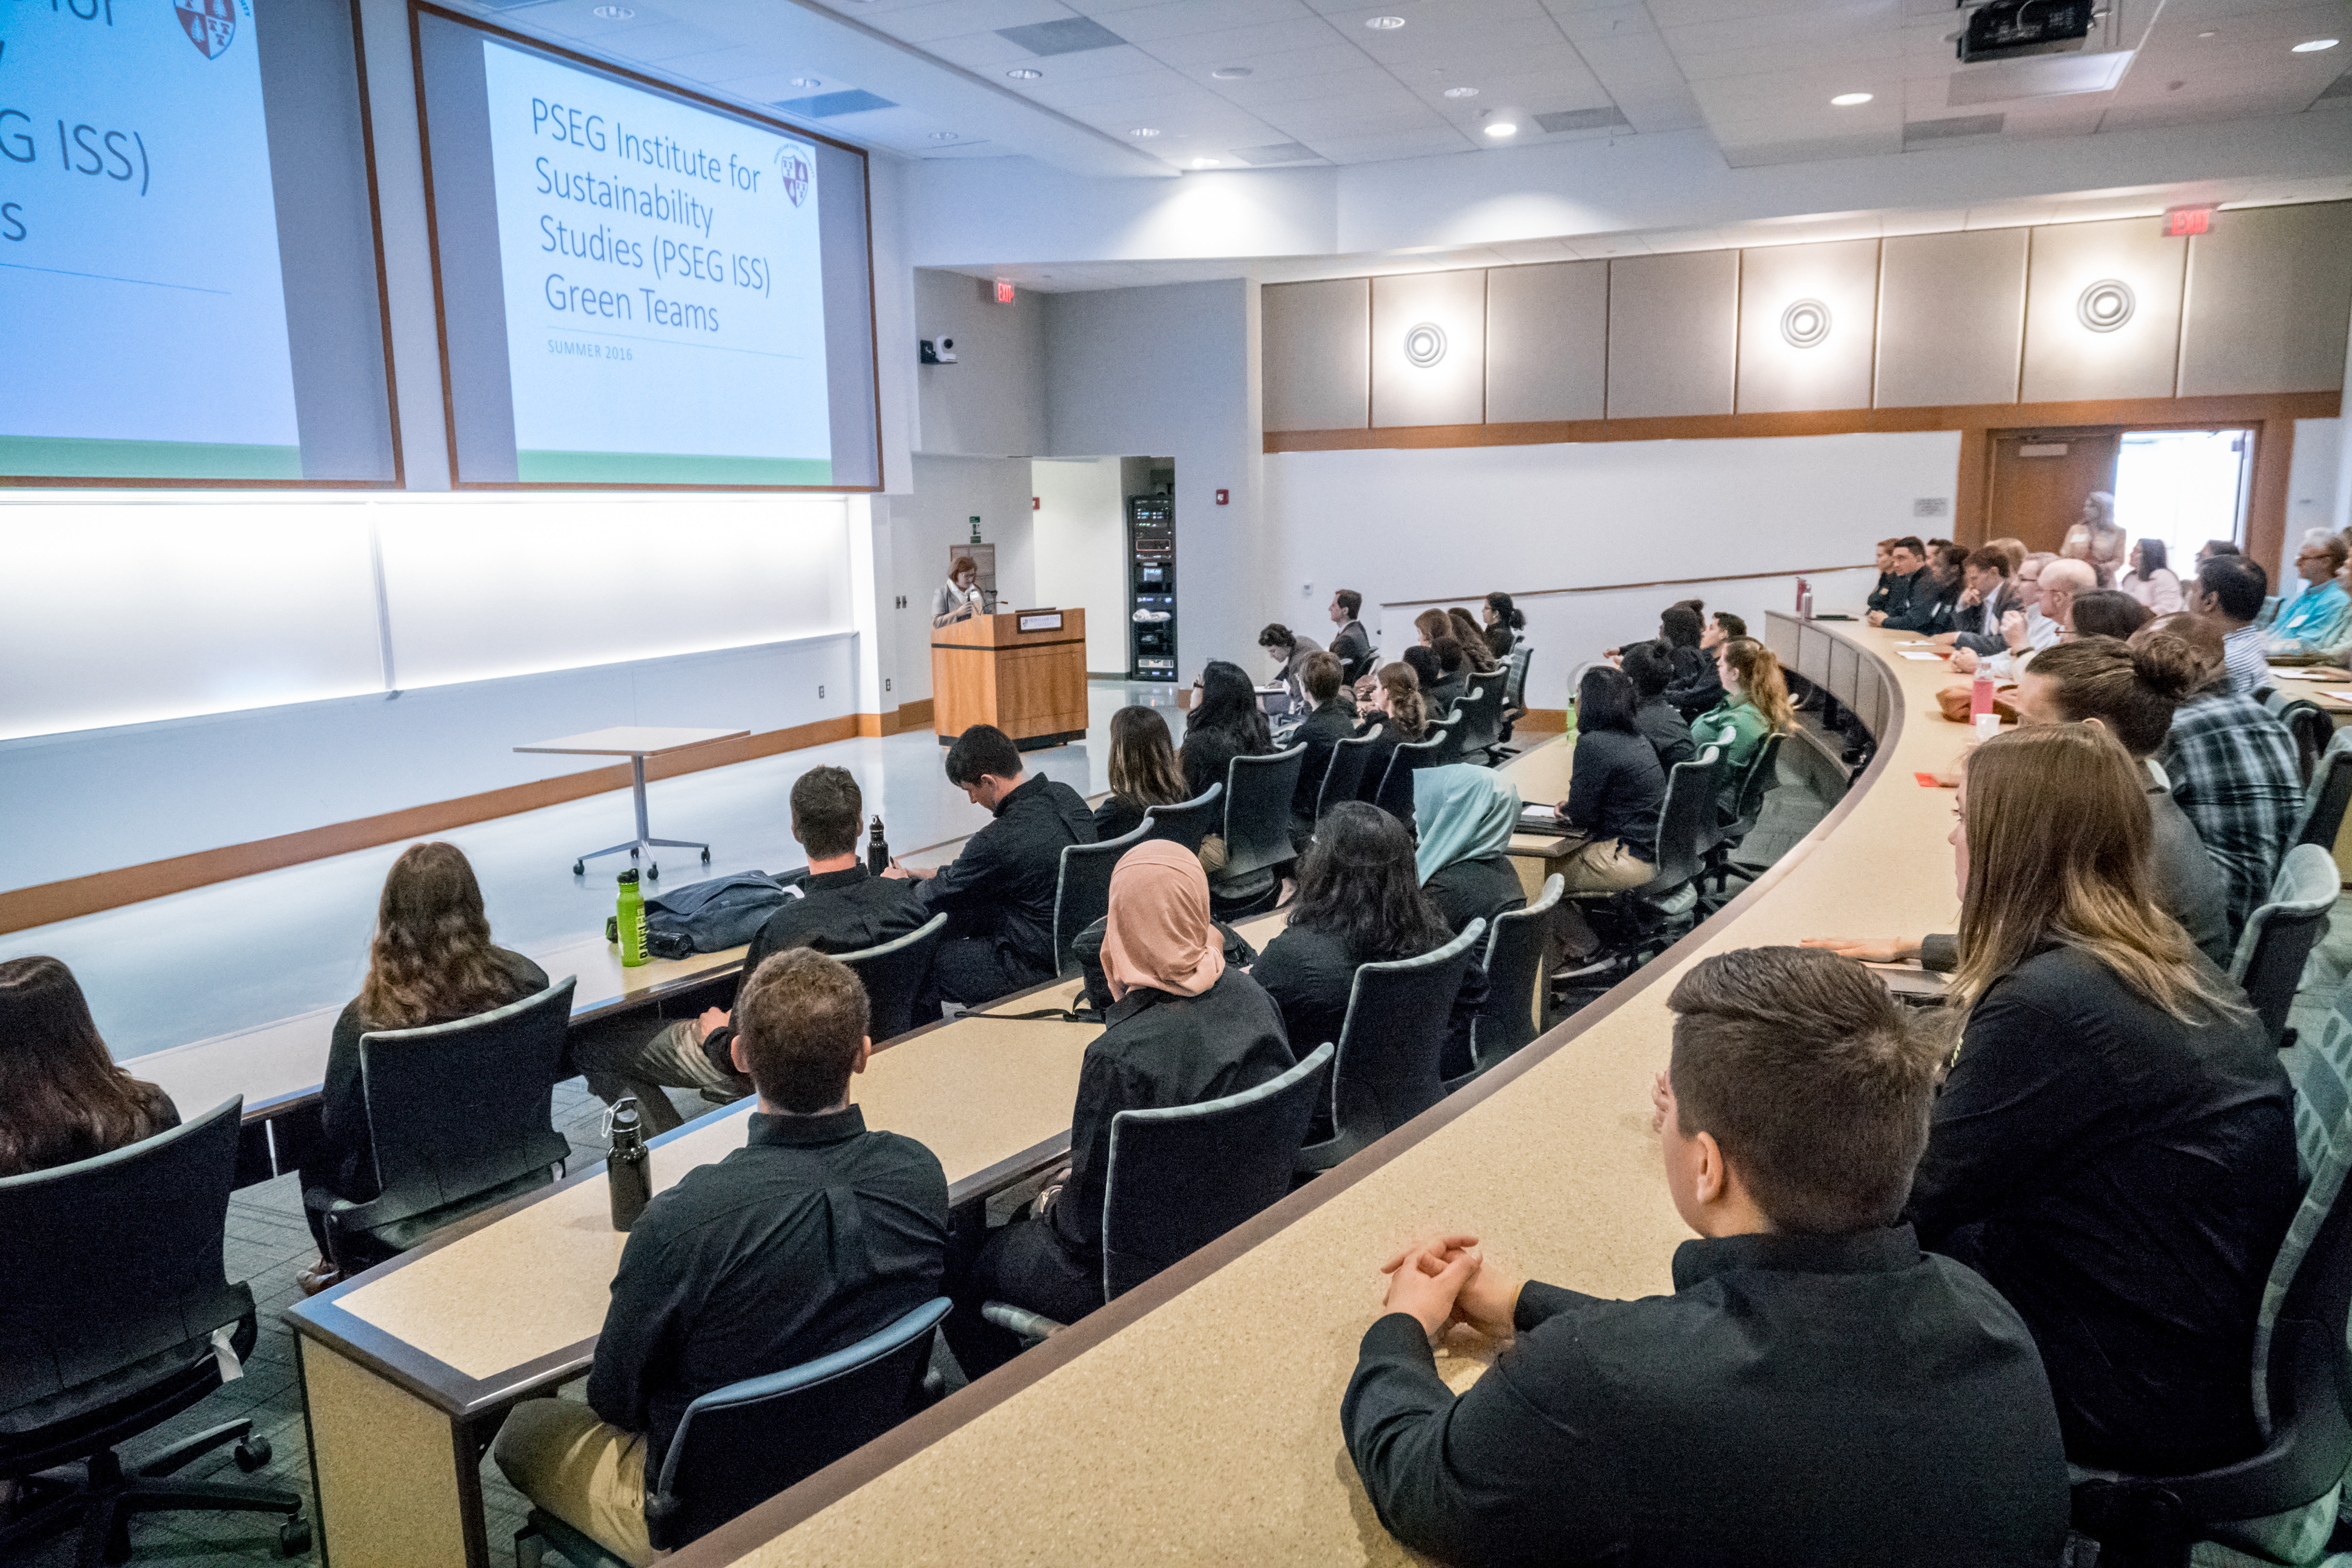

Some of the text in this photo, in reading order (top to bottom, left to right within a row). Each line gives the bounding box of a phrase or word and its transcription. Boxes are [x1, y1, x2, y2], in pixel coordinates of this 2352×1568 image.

[58, 119, 149, 197] ISS)
[532, 98, 606, 152] PSEG
[617, 122, 722, 183] Institute
[728, 154, 761, 193] for
[535, 156, 713, 238] Sustainability
[2171, 209, 2212, 235] EXIT
[540, 214, 770, 299] Studies (PSEG ISS)
[545, 274, 720, 332] Green Teams
[998, 282, 1012, 303] EXIT
[548, 339, 633, 361] SUMMER 2016
